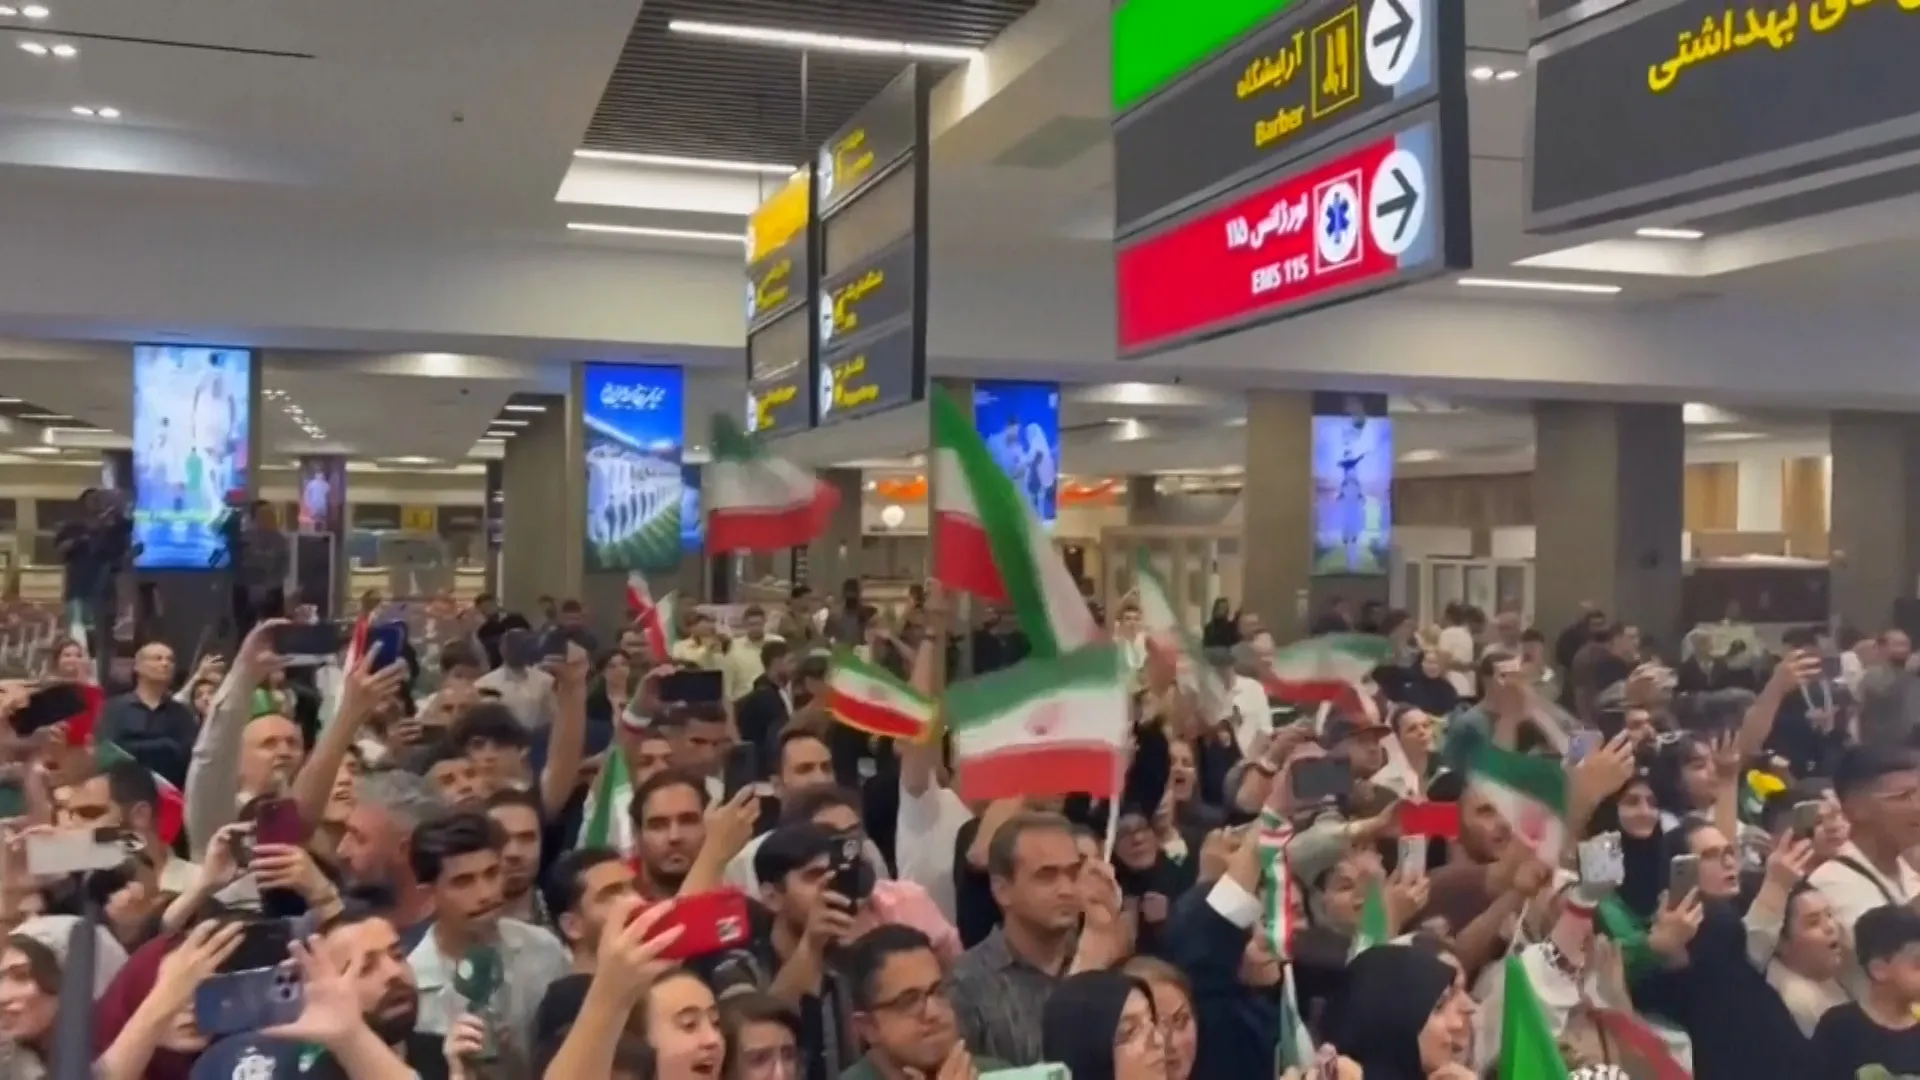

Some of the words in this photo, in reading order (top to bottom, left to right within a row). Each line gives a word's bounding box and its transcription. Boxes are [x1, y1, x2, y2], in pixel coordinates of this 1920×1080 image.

[1236, 30, 1305, 98] آرایشگاه
[1648, 2, 1799, 92] بهداشتی
[1255, 104, 1305, 146] Barber
[1251, 262, 1281, 294] EMS
[1284, 253, 1309, 284] 115
